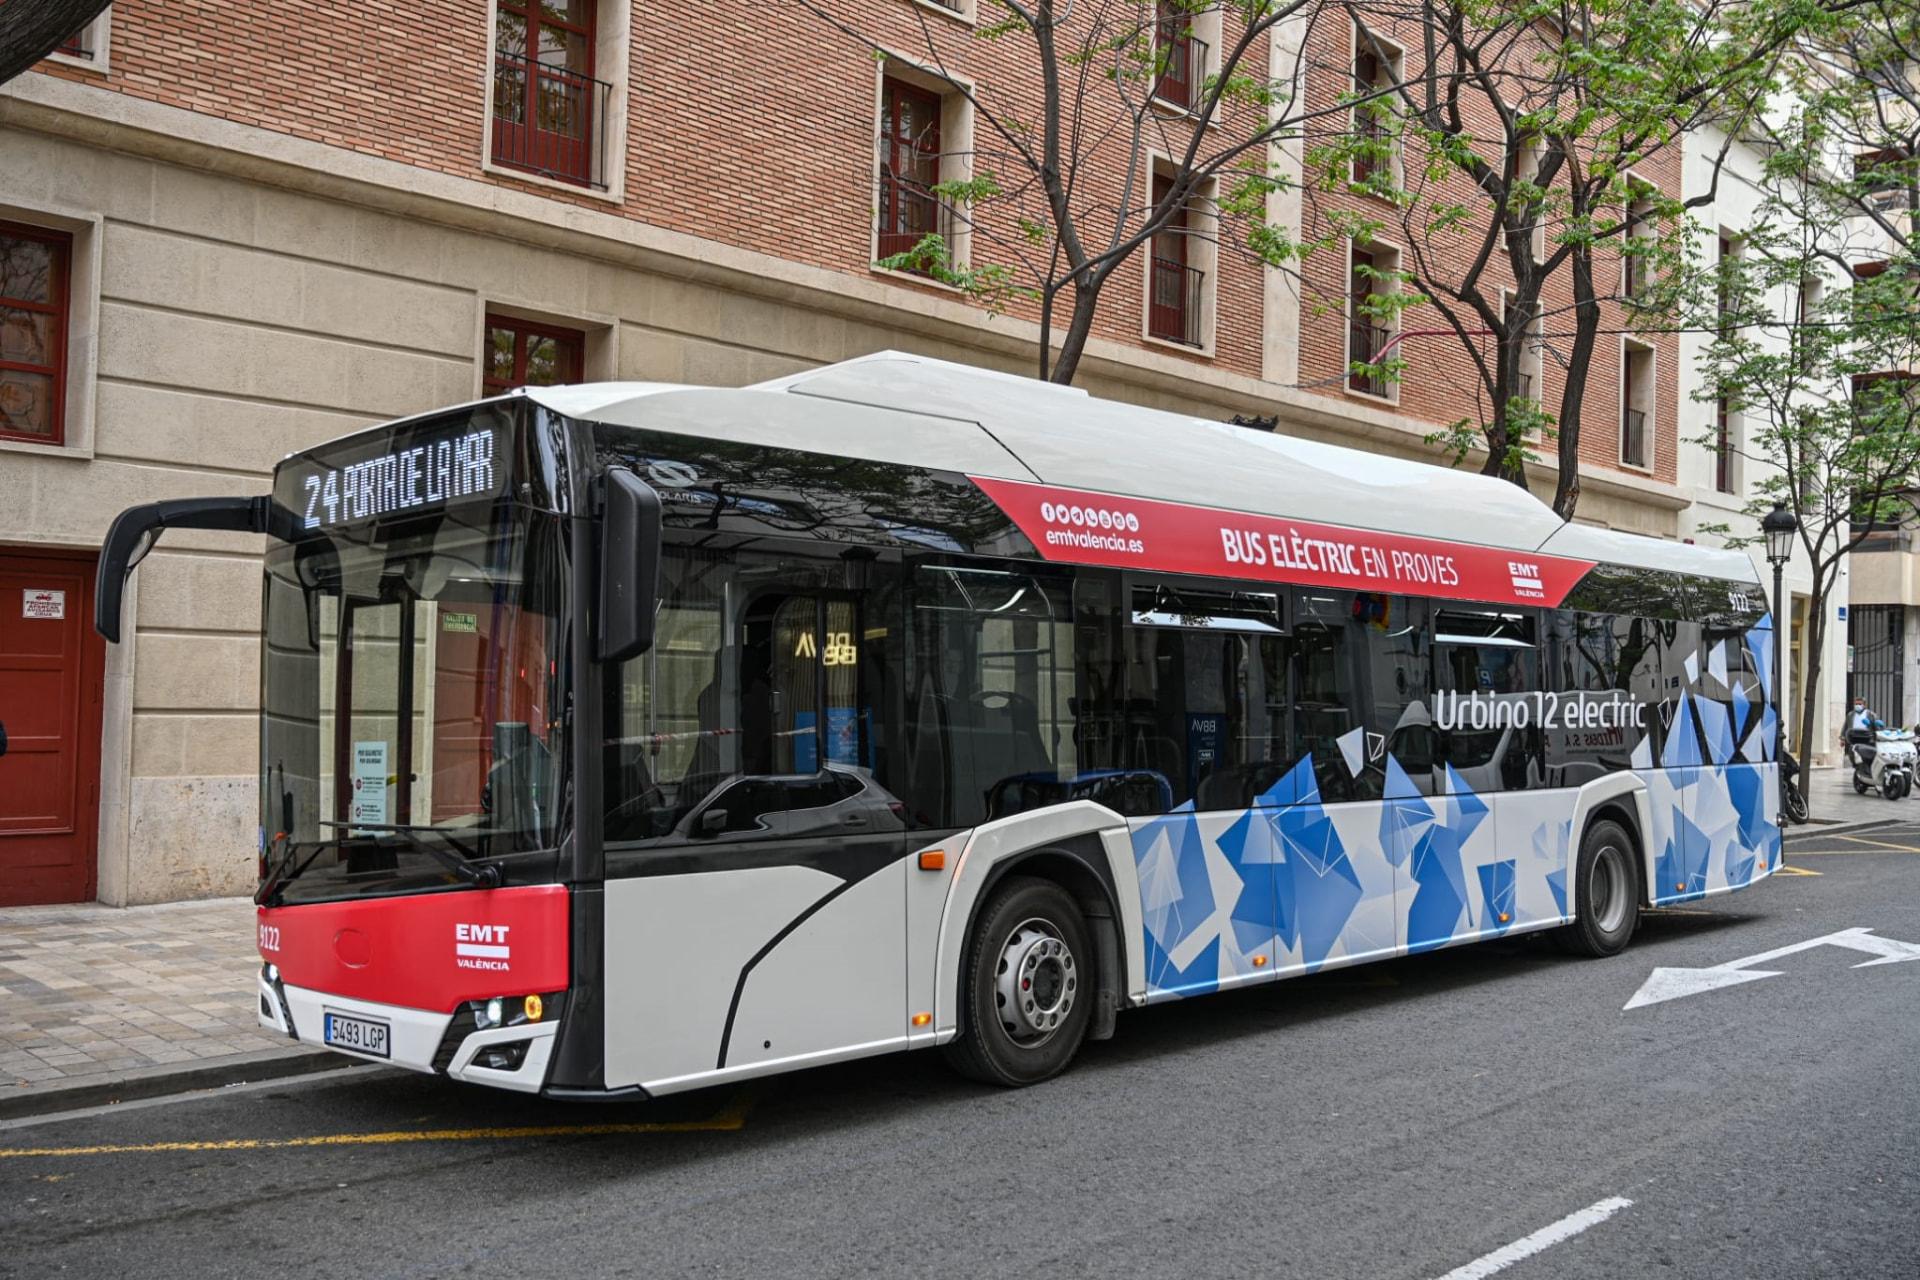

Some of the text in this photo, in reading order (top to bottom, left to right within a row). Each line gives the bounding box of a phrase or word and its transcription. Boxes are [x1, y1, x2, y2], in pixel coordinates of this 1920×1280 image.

[304, 429, 494, 529] 24 PORTA DE LA MAR
[658, 490, 702, 504] OLARIS
[1046, 529, 1144, 554] emtvalencia.es
[1220, 528, 1460, 586] BUS ELÈCTRIC EN PROVES
[1507, 561, 1539, 578] EMT
[1728, 592, 1751, 612] 9122
[1436, 688, 1647, 731] Urbino 12 electric
[260, 924, 281, 952] 9122
[456, 923, 510, 943] EMT
[333, 1019, 385, 1050] 5493 LGP
